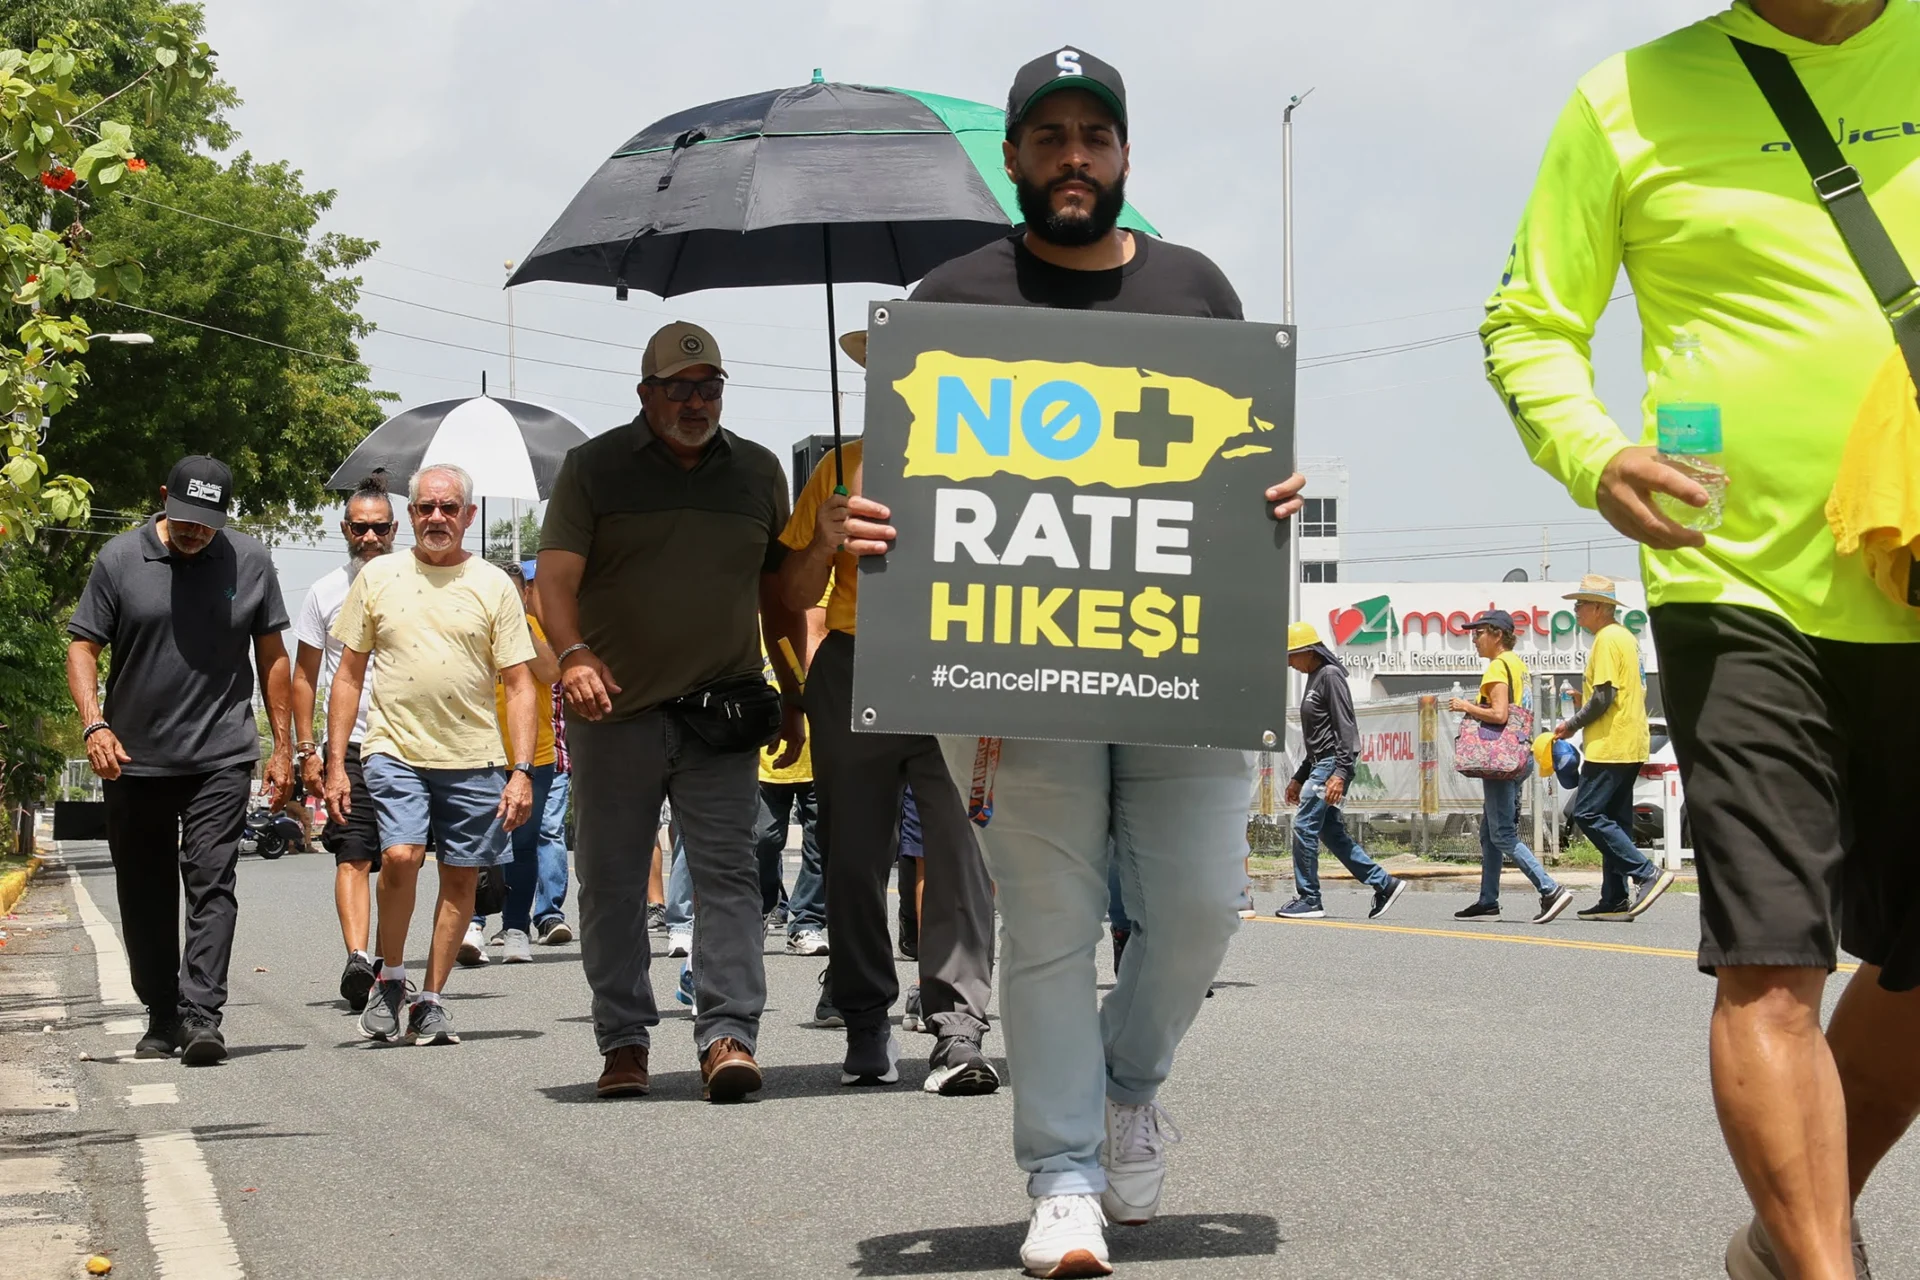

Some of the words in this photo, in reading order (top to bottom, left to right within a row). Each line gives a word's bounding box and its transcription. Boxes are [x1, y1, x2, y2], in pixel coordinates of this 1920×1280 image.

[1056, 50, 1083, 77] S
[933, 488, 1195, 576] RATE
[929, 581, 1202, 659] HIKE$!
[1403, 601, 1649, 643] maetpe
[1334, 651, 1374, 670] akery,
[931, 664, 1200, 700] #CancelPREPADebt
[1361, 733, 1375, 762] LA
[1377, 731, 1415, 762] OFICIAL
